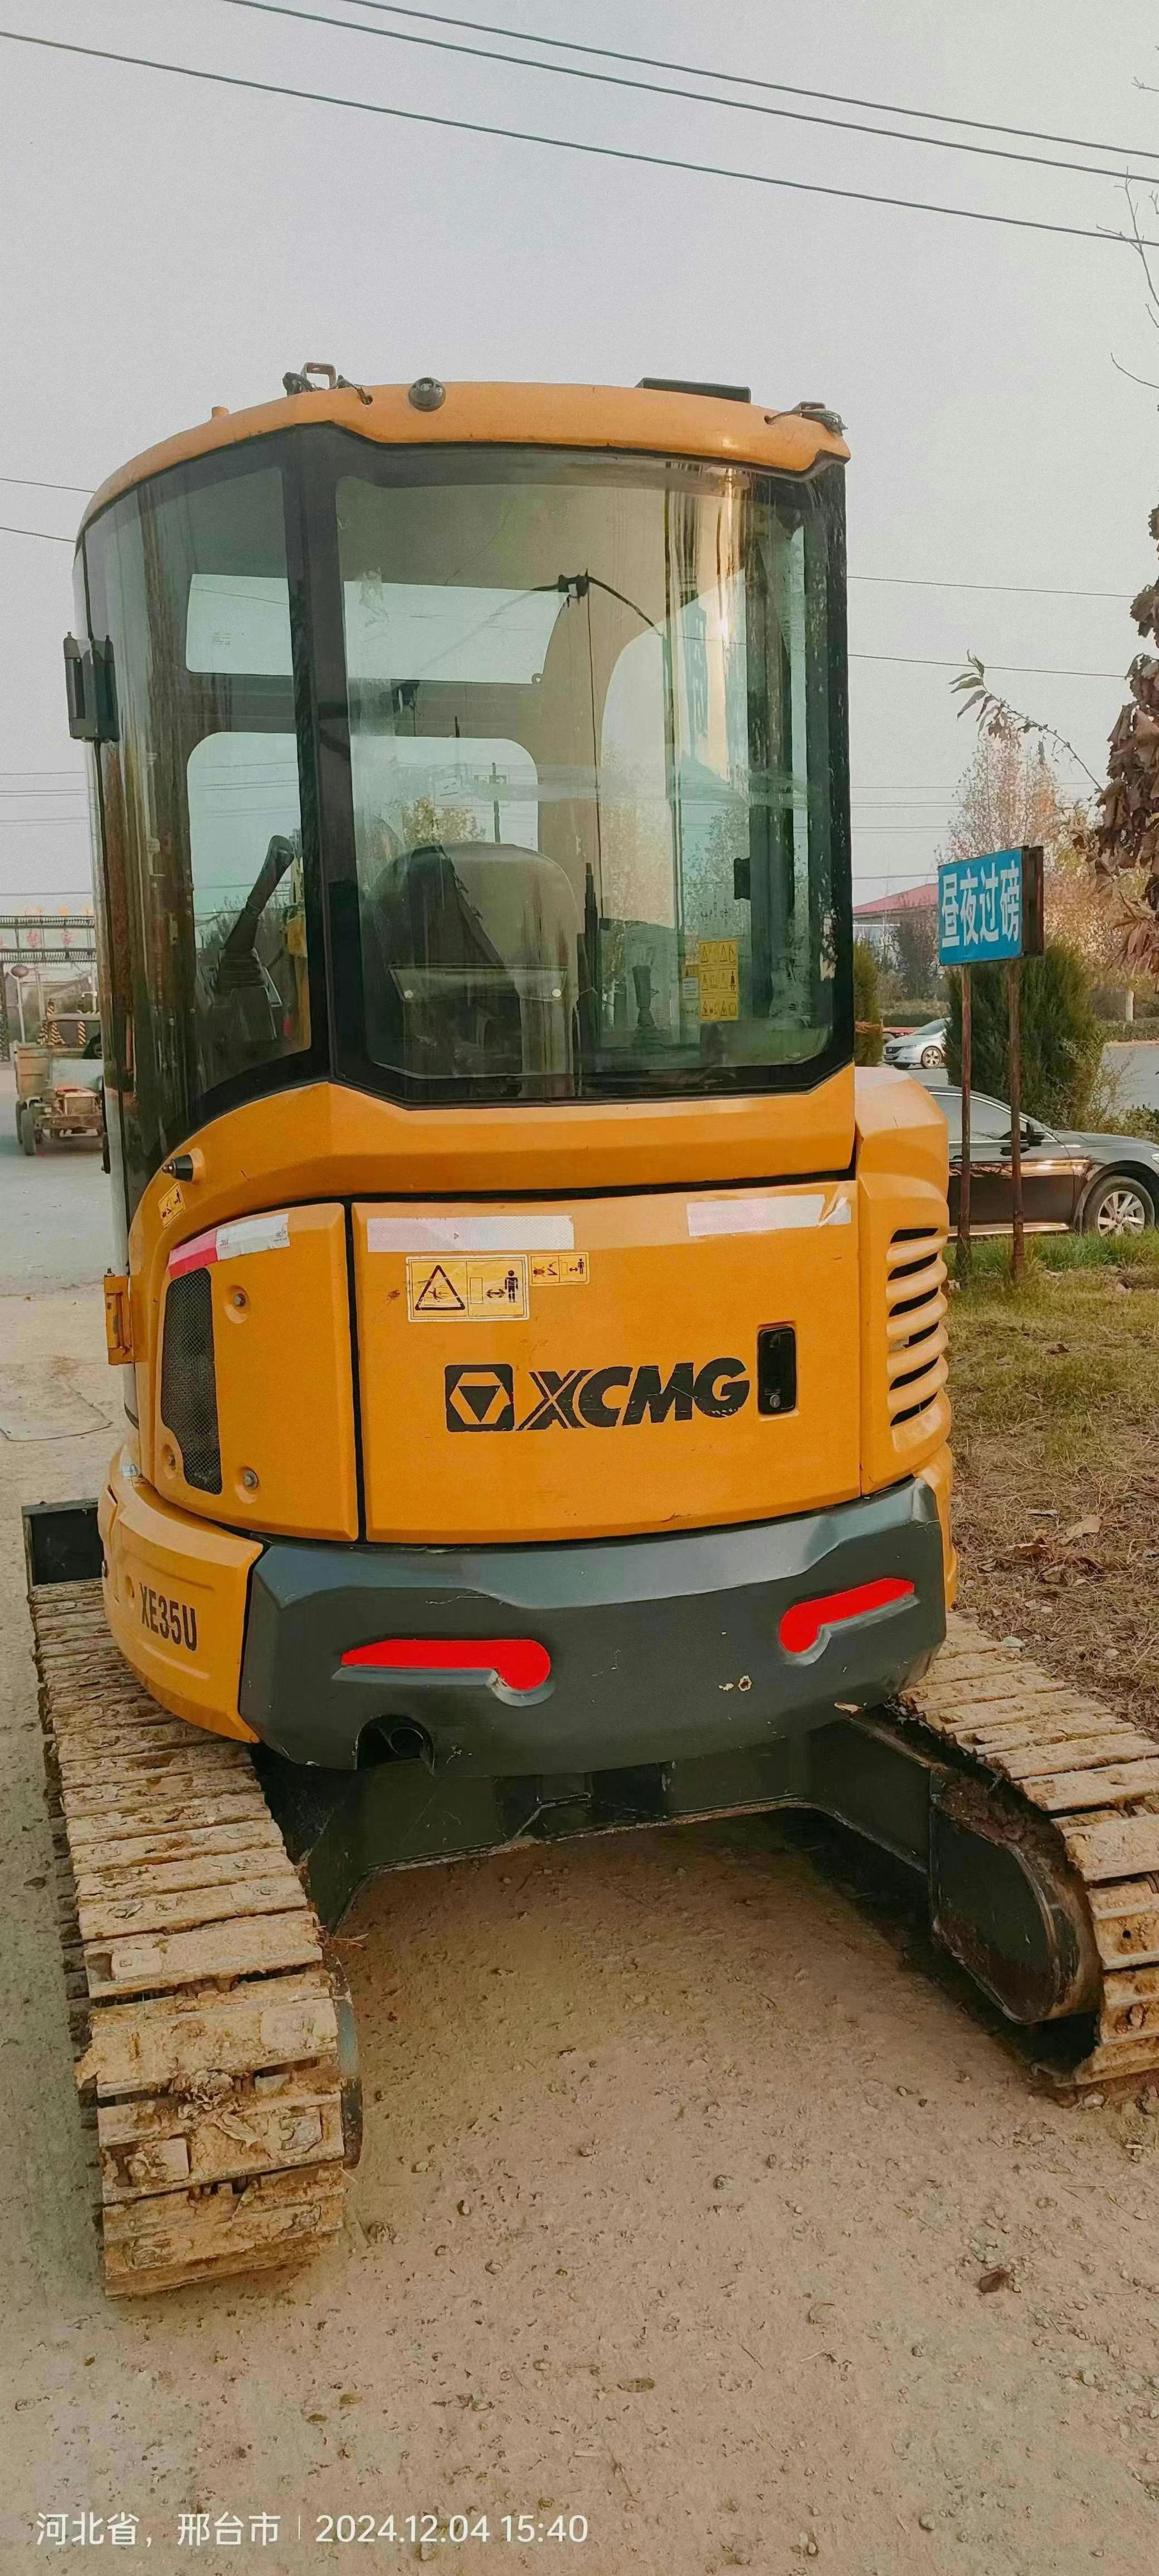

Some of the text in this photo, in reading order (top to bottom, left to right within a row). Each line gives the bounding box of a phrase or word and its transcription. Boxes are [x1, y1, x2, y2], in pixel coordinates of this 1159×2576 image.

[942, 860, 1019, 948] 昼夜过磅
[515, 1357, 750, 1431] XCMG
[139, 1582, 197, 1651] XE35U
